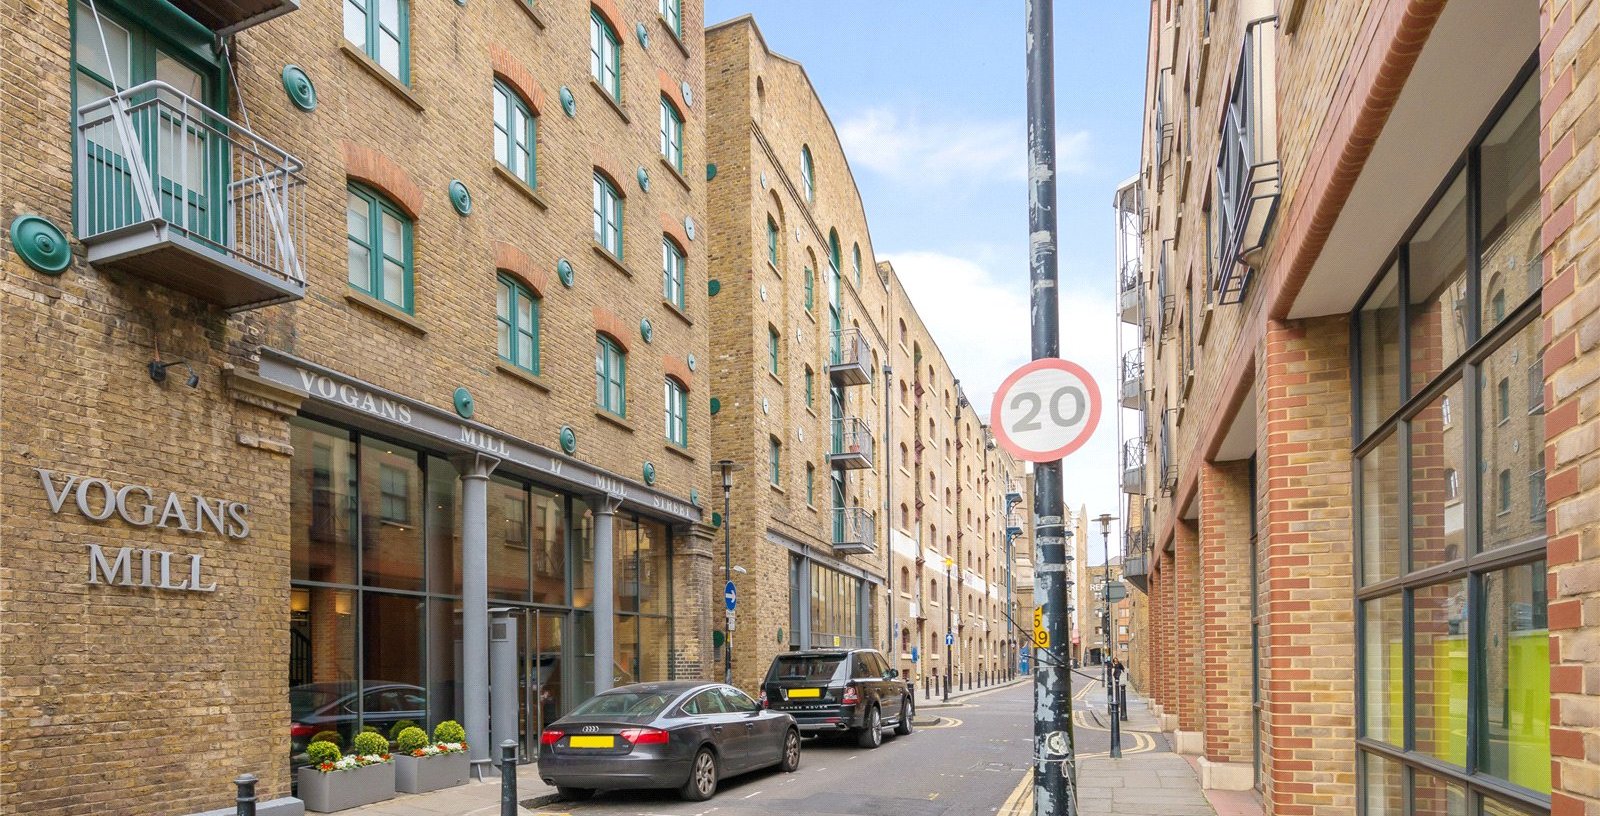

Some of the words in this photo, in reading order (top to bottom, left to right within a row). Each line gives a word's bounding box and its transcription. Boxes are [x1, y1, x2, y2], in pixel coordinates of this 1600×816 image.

[1010, 385, 1086, 433] 20
[296, 367, 412, 424] VOGANS
[460, 425, 510, 456] MILL
[550, 458, 562, 474] 17
[594, 473, 628, 497] MILL
[653, 495, 690, 517] STREET
[35, 468, 250, 540] VOGANS
[86, 543, 217, 592] MILL
